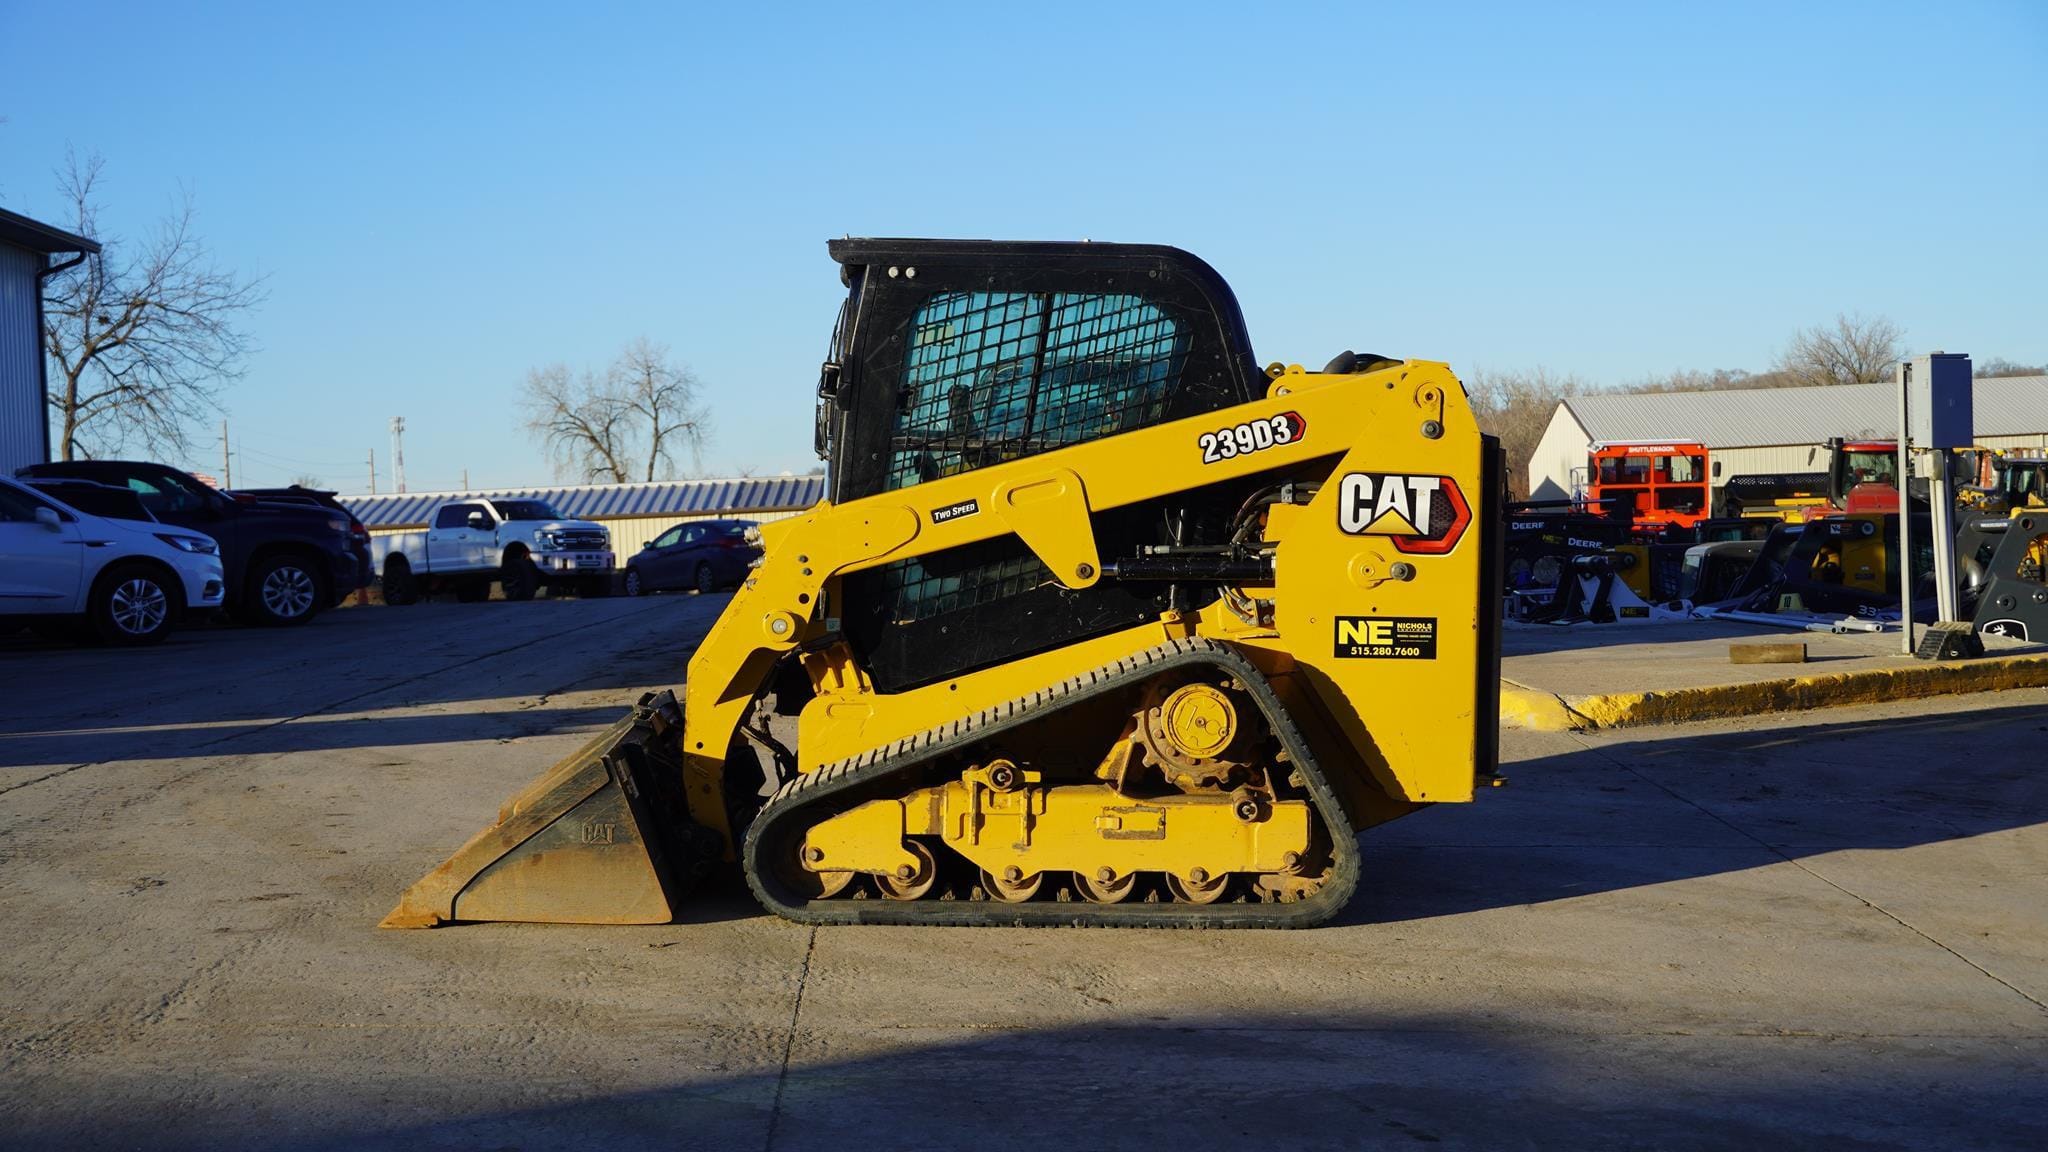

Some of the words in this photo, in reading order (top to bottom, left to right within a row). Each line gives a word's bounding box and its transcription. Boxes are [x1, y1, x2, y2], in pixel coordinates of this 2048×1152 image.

[1199, 415, 1292, 463] 239D3
[1339, 473, 1440, 536] CAT
[1567, 537, 1603, 549] DEERE
[1338, 619, 1394, 645] NE
[1396, 622, 1433, 630] NICHOLS
[1350, 646, 1420, 656] 515.280.7600
[581, 823, 616, 844] CAT
